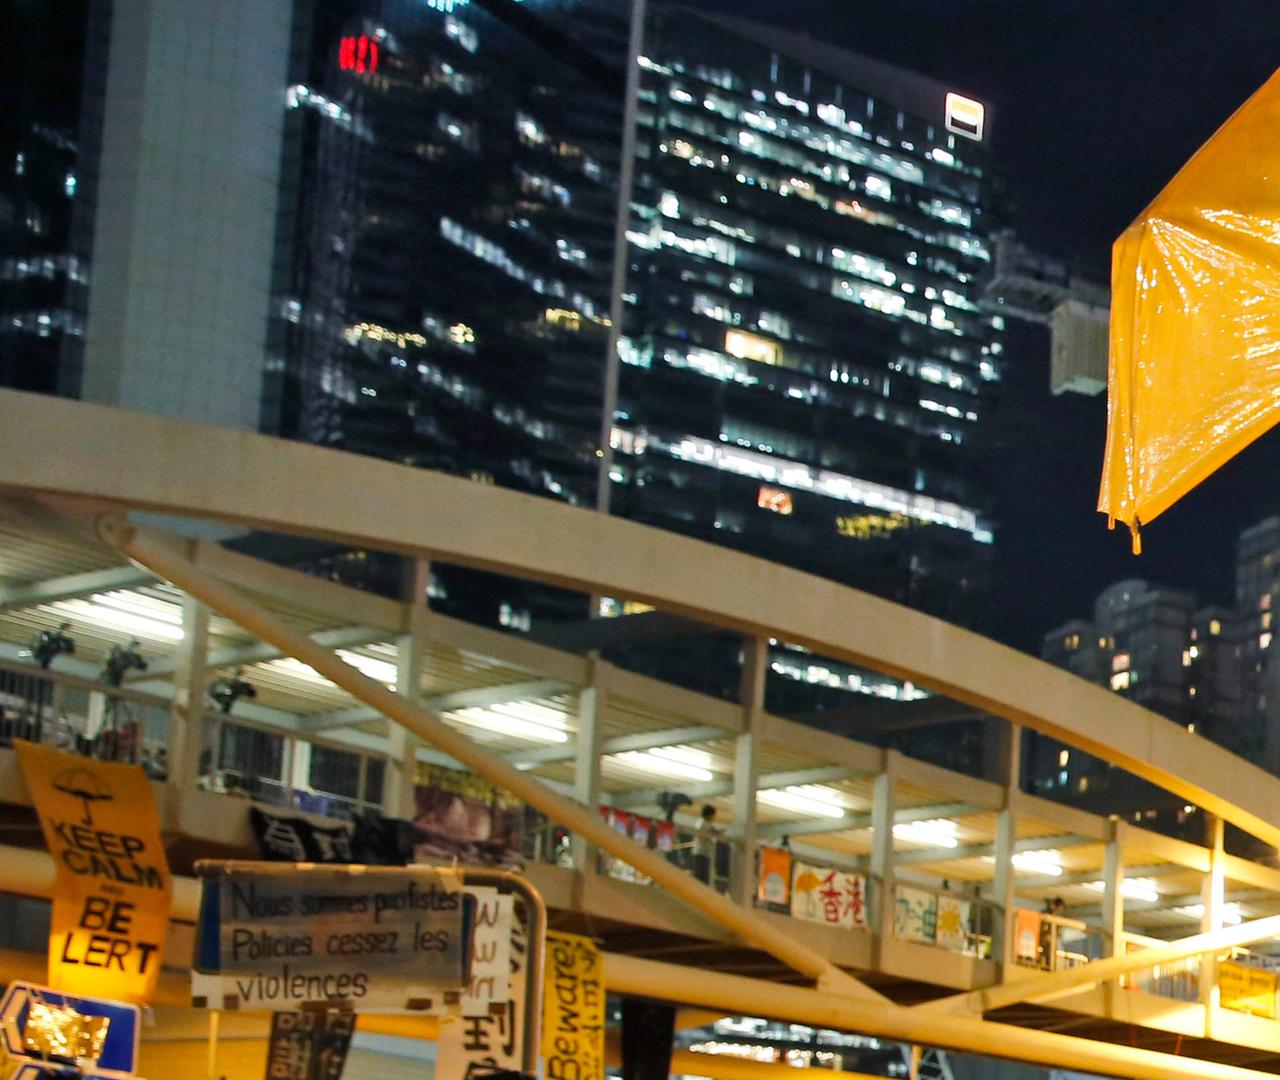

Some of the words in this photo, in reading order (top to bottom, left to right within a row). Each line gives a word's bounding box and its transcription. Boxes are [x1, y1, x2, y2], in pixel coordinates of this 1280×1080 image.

[52, 817, 145, 861] KEEP
[62, 849, 165, 891] CALM
[79, 894, 136, 935] BE
[818, 867, 866, 926] 香港
[325, 931, 400, 955] cessez
[413, 921, 450, 953] les
[236, 962, 370, 1001] violences
